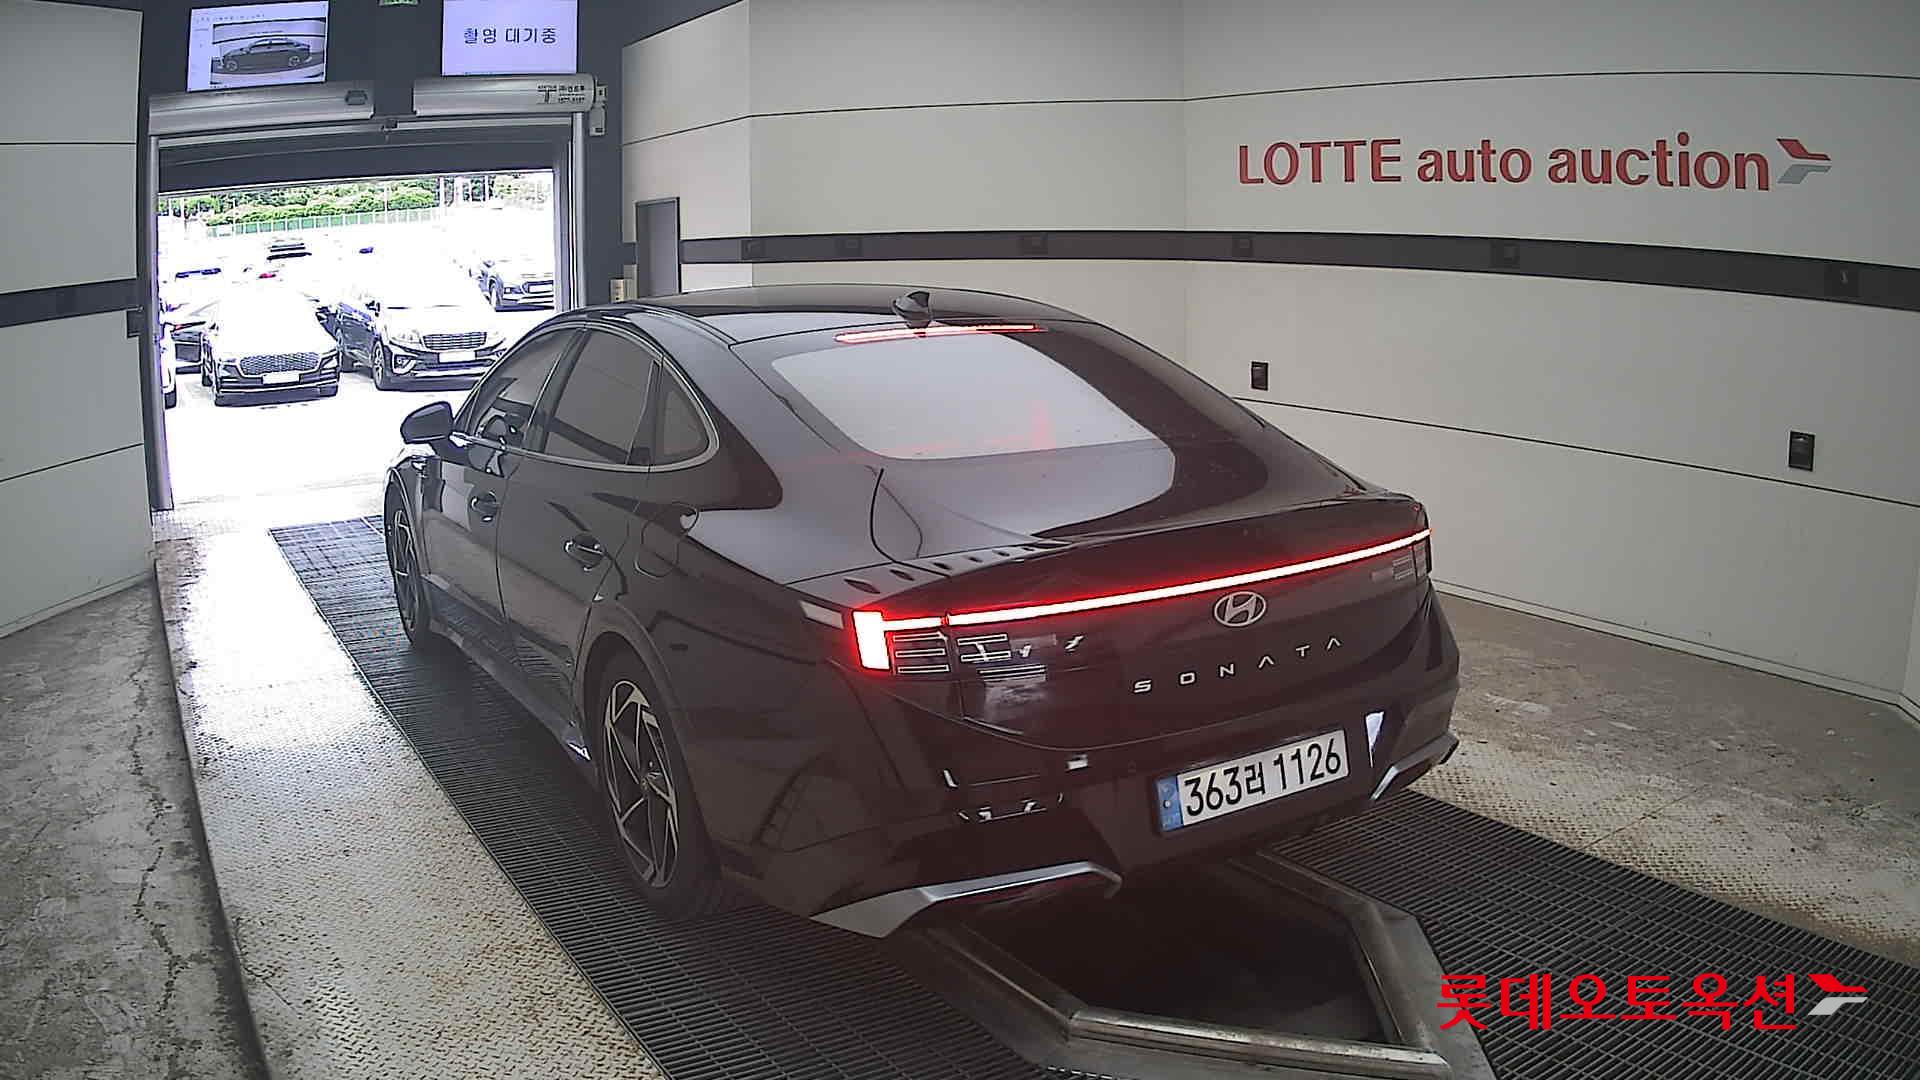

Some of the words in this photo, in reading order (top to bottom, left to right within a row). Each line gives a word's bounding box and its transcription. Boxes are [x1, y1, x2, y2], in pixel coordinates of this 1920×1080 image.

[504, 27, 558, 45] 대기중
[1239, 138, 1401, 185] LOTTE
[1417, 138, 1534, 184] auto
[1547, 132, 1772, 191] auction
[1133, 636, 1341, 694] SONATA
[1183, 761, 1267, 817] 363러
[1272, 737, 1342, 791] 1126
